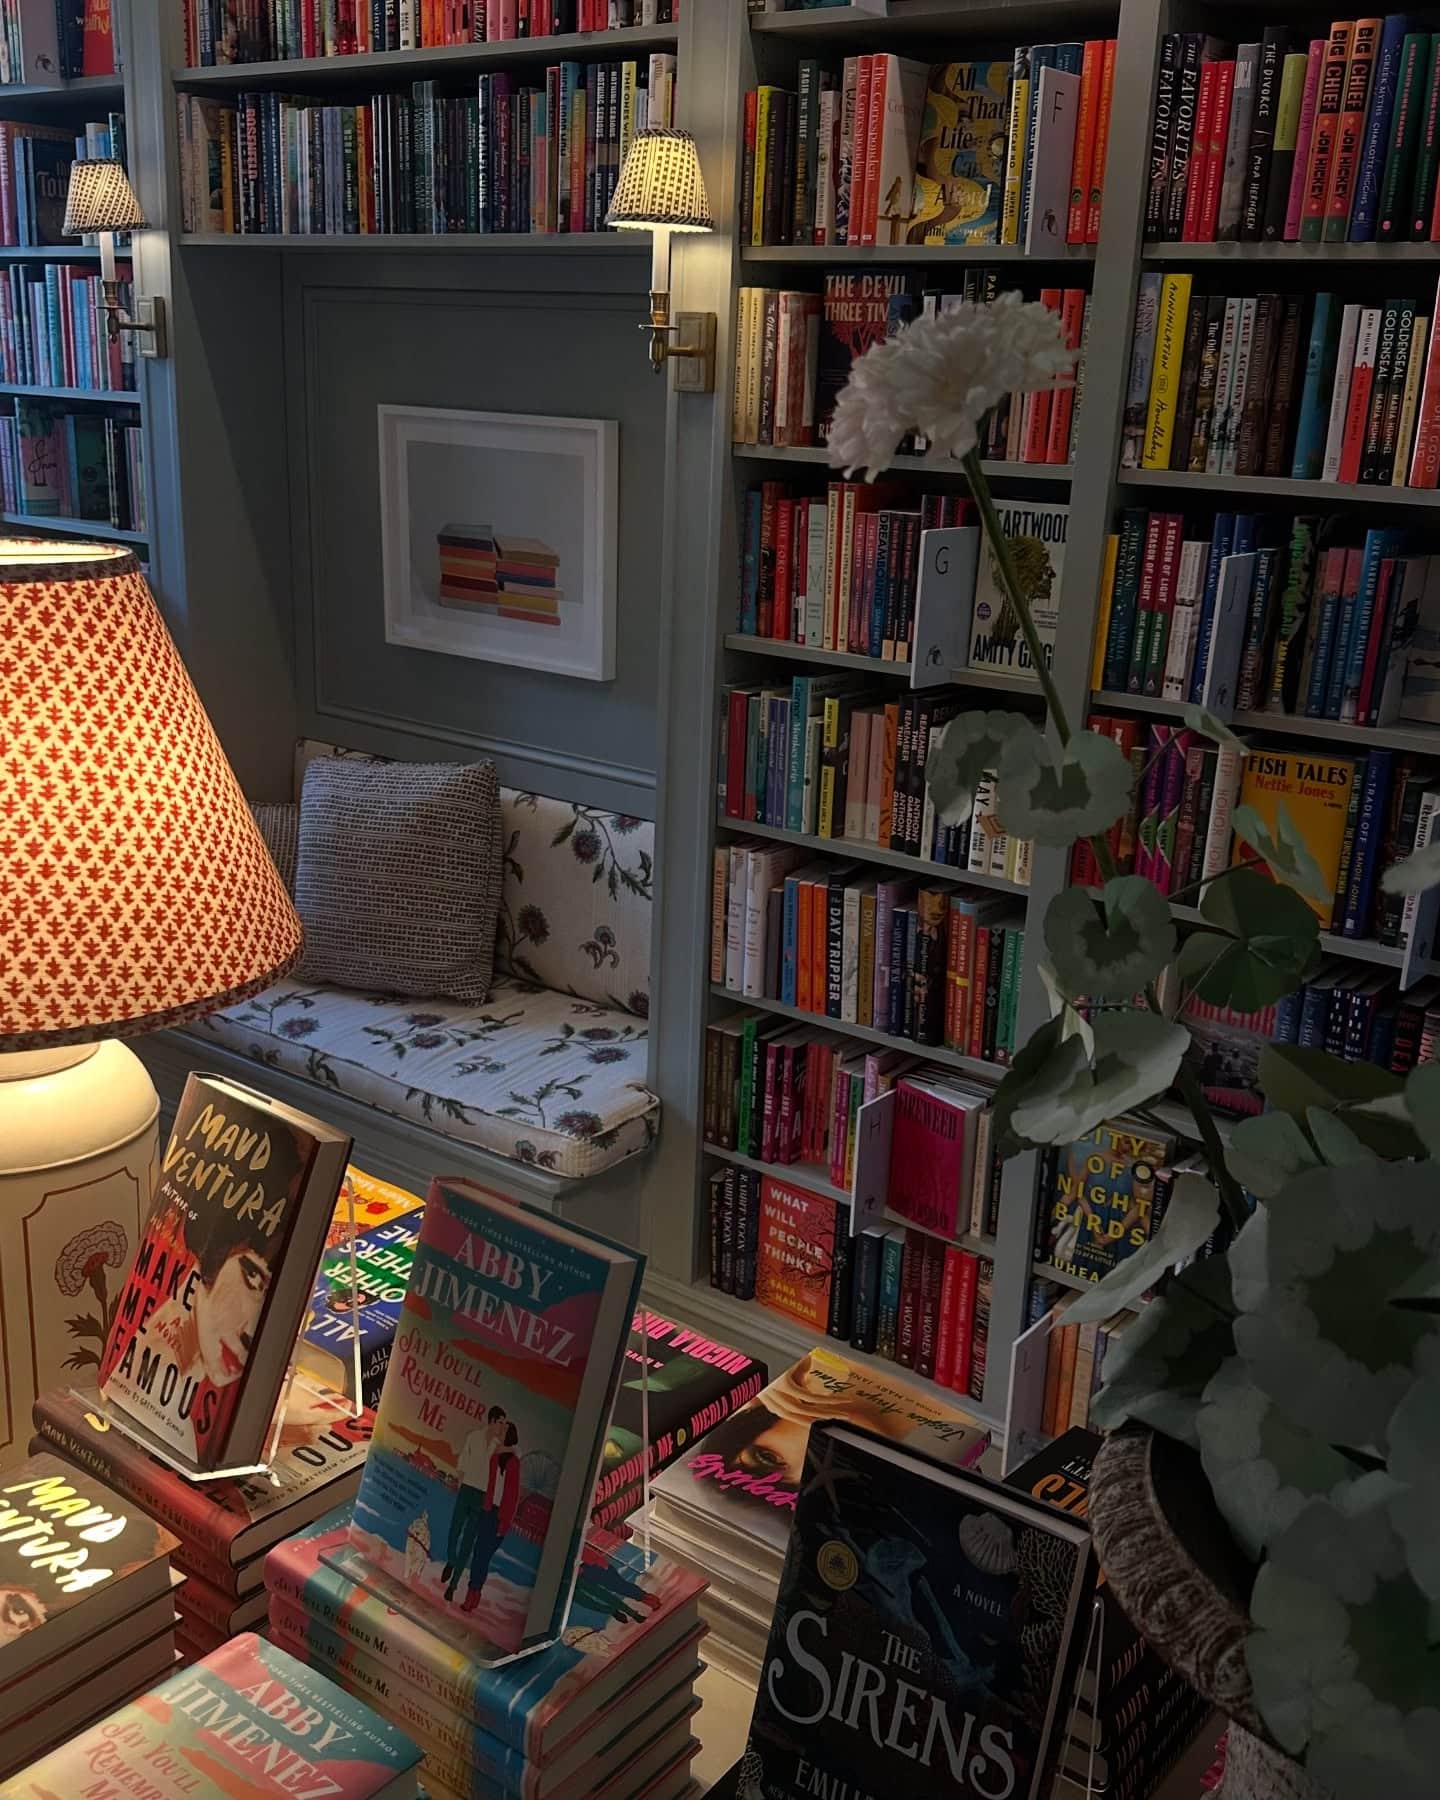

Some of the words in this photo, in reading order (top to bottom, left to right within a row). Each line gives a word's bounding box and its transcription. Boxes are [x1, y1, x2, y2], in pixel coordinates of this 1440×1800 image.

[1163, 42, 1174, 63] THE
[1185, 42, 1197, 64] THE
[1266, 42, 1277, 65] THE
[1330, 29, 1347, 57] BIG
[1355, 27, 1373, 55] BIG
[876, 64, 887, 86] The
[952, 68, 976, 93] All
[1258, 68, 1274, 118] DIVORCE
[1321, 64, 1344, 114] CHIEF
[1345, 62, 1369, 113] CHIEF
[842, 89, 855, 137] Wedding
[966, 96, 1007, 122] That
[1010, 105, 1021, 150] AMERICAN
[1150, 69, 1174, 181] FAVORITES
[1171, 69, 1197, 181] FAVORITES
[246, 107, 259, 180] ROSENFELD
[852, 87, 868, 183] Correspondent
[867, 88, 883, 182] Correspondent
[940, 126, 974, 150] Life
[1316, 130, 1328, 155] JON
[1341, 128, 1353, 152] JON
[1311, 156, 1326, 201] HICKEY
[1335, 153, 1350, 200] HICKEY
[1246, 181, 1260, 231] HERNGREN
[825, 273, 859, 298] THE
[861, 272, 908, 298] DEVIL
[824, 302, 865, 323] THREE
[1158, 281, 1179, 370] ANNIHILATION
[1208, 321, 1219, 338] The
[1225, 313, 1234, 348] TRUE
[1241, 313, 1251, 348] TRUE
[1205, 339, 1217, 361] Other
[1375, 310, 1397, 380] GOLDENSEAL
[1392, 309, 1413, 380] GOLDENSEAL
[1200, 362, 1214, 389] Valley
[1216, 351, 1230, 406] ACCOUNT
[1232, 351, 1247, 407] ACCOUNT
[873, 514, 889, 607] DREAMBOUND
[935, 547, 950, 575] G
[1147, 527, 1159, 560] SEASON
[1163, 529, 1176, 562] SEASON
[1140, 575, 1153, 602] LIGHT
[1157, 578, 1170, 604] LIGHT
[974, 634, 1015, 665] AMITY
[789, 721, 802, 759] Monkey
[902, 710, 912, 762] REMEMBER
[916, 713, 928, 767] REMEMBER
[789, 760, 800, 783] Grip
[1249, 755, 1288, 776] FISH
[1296, 762, 1348, 786] TALES
[1254, 774, 1292, 792] Nettie
[1299, 780, 1336, 800] Jones
[895, 791, 906, 838] ANTHONY
[910, 797, 921, 844] ANTHONY
[1362, 782, 1377, 819] TRADE
[1358, 822, 1371, 845] OFF
[1416, 804, 1433, 849] REUNION
[1349, 883, 1361, 912] JONES
[830, 906, 843, 936] DAY
[828, 938, 842, 1001] TRIPPER
[187, 1102, 273, 1171] MAUD
[1080, 1129, 1146, 1160] ITY
[162, 1134, 288, 1237] VENTURA
[722, 1167, 736, 1209] RABBIT
[1087, 1156, 1126, 1181] OF
[161, 1180, 188, 1212] AUTHOR
[185, 1208, 200, 1222] OF
[738, 1173, 750, 1216] RABBIT
[770, 1186, 809, 1214] WHAT
[1056, 1172, 1152, 1218] NIGHT
[721, 1209, 735, 1248] MOON
[736, 1214, 747, 1252] MOON
[764, 1204, 798, 1229] WILL
[1055, 1200, 1146, 1249] BIRDS
[769, 1226, 824, 1261] PEOPLE
[135, 1238, 202, 1312] MAKE
[452, 1231, 556, 1303] ABBY
[1044, 1255, 1101, 1285] JUHEA
[122, 1287, 156, 1335] ME
[414, 1260, 577, 1369] JIMENEZ
[775, 1291, 818, 1321] HAMDAN
[901, 1304, 914, 1347] WOMEN
[671, 1332, 754, 1377] NICOLA
[921, 1314, 934, 1358] WOMEN
[109, 1324, 217, 1435] FAMOUS
[400, 1357, 488, 1421] REMEMBER
[417, 1399, 448, 1434] ME
[689, 1394, 729, 1436] NICOLA
[729, 1370, 763, 1413] DINAN
[67, 1436, 113, 1479] VENTURA
[3, 1476, 127, 1543] MAUD
[952, 1584, 963, 1599] A
[965, 1590, 1003, 1618] NOVEL
[880, 1629, 923, 1675] THE
[236, 1678, 354, 1755] ABBY
[767, 1608, 1017, 1800] SIRENS
[164, 1680, 344, 1800] JIMENEZ
